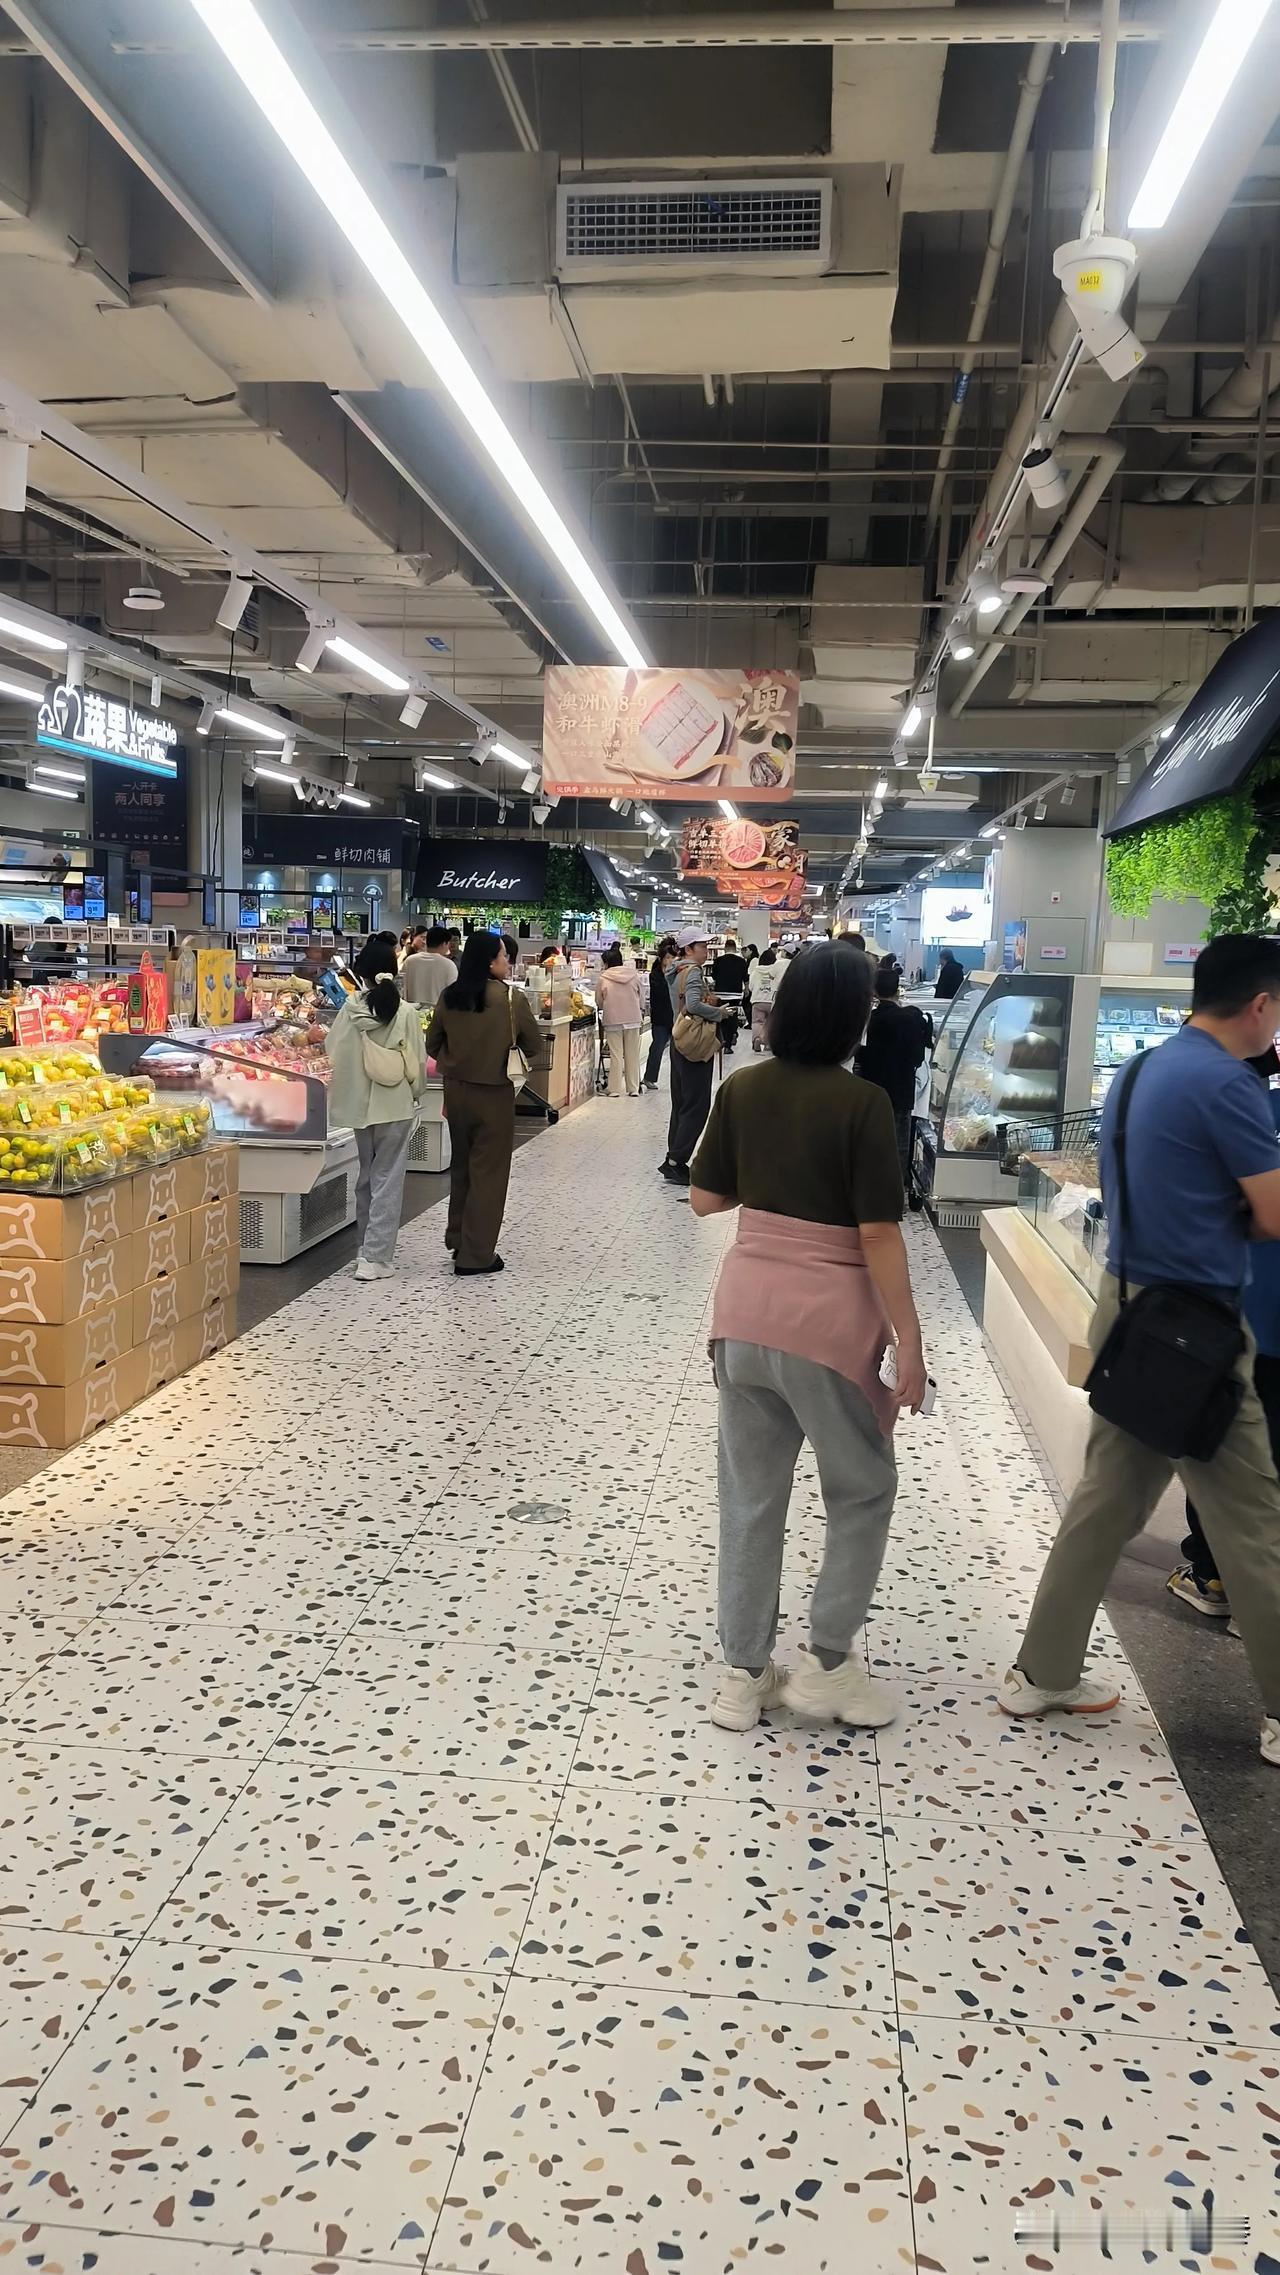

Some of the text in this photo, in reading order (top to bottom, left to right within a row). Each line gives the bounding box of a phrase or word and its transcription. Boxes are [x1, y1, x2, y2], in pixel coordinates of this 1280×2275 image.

[734, 677, 791, 736] 澳
[84, 693, 129, 754] 蔬果
[128, 709, 178, 745] Vegetable
[115, 792, 166, 807] 两人同享
[334, 847, 391, 864] 鲜切肉铺
[437, 870, 521, 890] Butcher
